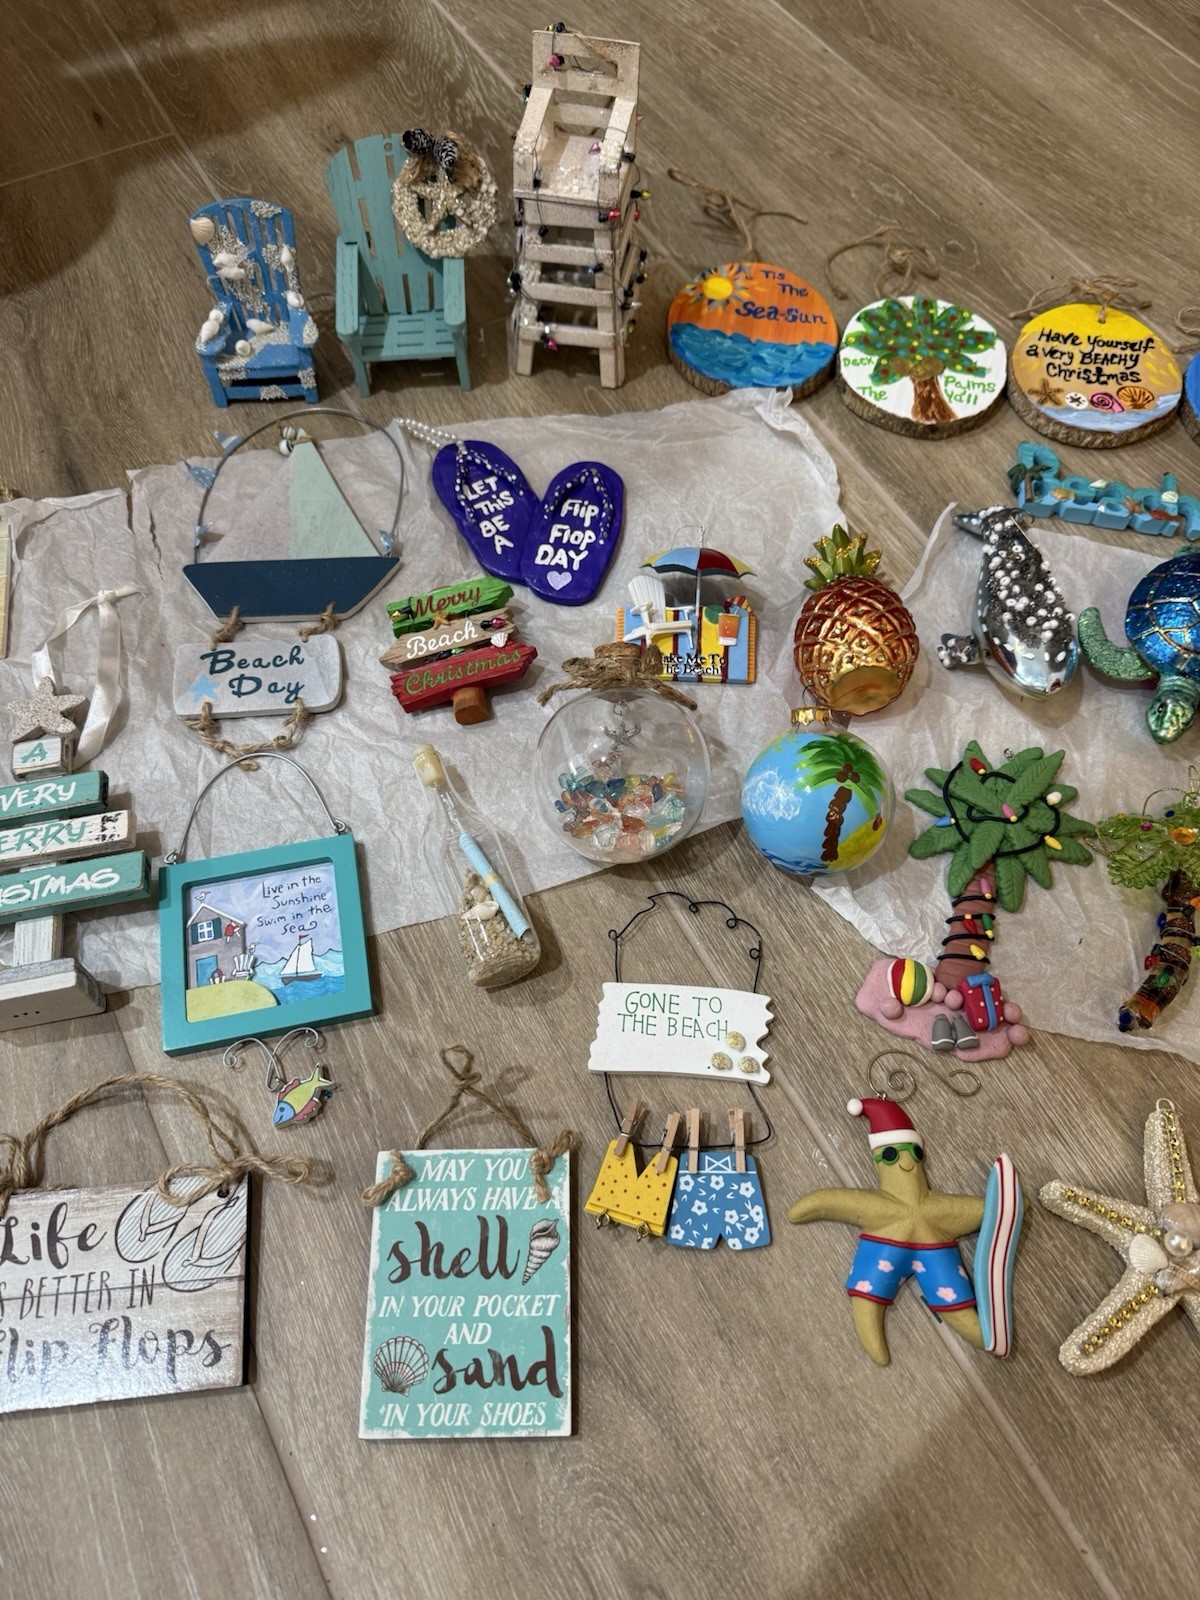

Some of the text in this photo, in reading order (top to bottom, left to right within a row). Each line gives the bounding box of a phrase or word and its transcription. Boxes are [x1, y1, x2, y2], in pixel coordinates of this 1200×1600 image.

[777, 282, 809, 297] The
[735, 301, 828, 325] Sea-Sun
[1038, 327, 1082, 346] Have
[1026, 344, 1039, 358] a
[1042, 346, 1074, 366] very
[944, 376, 996, 393] Palms
[1046, 362, 1142, 386] Christmas
[857, 386, 888, 401] The
[462, 475, 498, 501] LET
[479, 514, 511, 538] BE
[560, 499, 600, 528] Flip
[494, 534, 514, 555] A
[549, 524, 596, 551] Flop
[534, 544, 589, 571] DAY
[412, 587, 480, 618] Merry
[406, 620, 479, 660] Beach
[200, 645, 305, 676] Beach
[662, 652, 683, 665] ake
[664, 663, 681, 675] he
[404, 650, 521, 696] Christmas
[228, 673, 305, 704] Day
[21, 742, 49, 764] A
[0, 781, 77, 811] VERY
[0, 821, 88, 854] ERRY
[0, 868, 120, 907] STMAS
[262, 875, 322, 899] Live in the
[271, 892, 327, 910] Sunshine
[256, 904, 332, 928] Swim in the
[625, 991, 723, 1017] GONE TO
[617, 1013, 729, 1041] THE BEACH
[418, 1157, 531, 1183] MAY YOU
[385, 1186, 479, 1212] ALWAYS
[481, 1186, 538, 1211] HAVE
[0, 1201, 108, 1270] Life
[386, 1214, 521, 1284] shell
[20, 1270, 112, 1321] BETTER
[126, 1264, 155, 1310] IN
[378, 1294, 562, 1318] IN YOUR POCKET
[443, 1322, 493, 1346] AND
[431, 1324, 565, 1399] sand
[381, 1401, 548, 1428] IN YOUR SHOES
